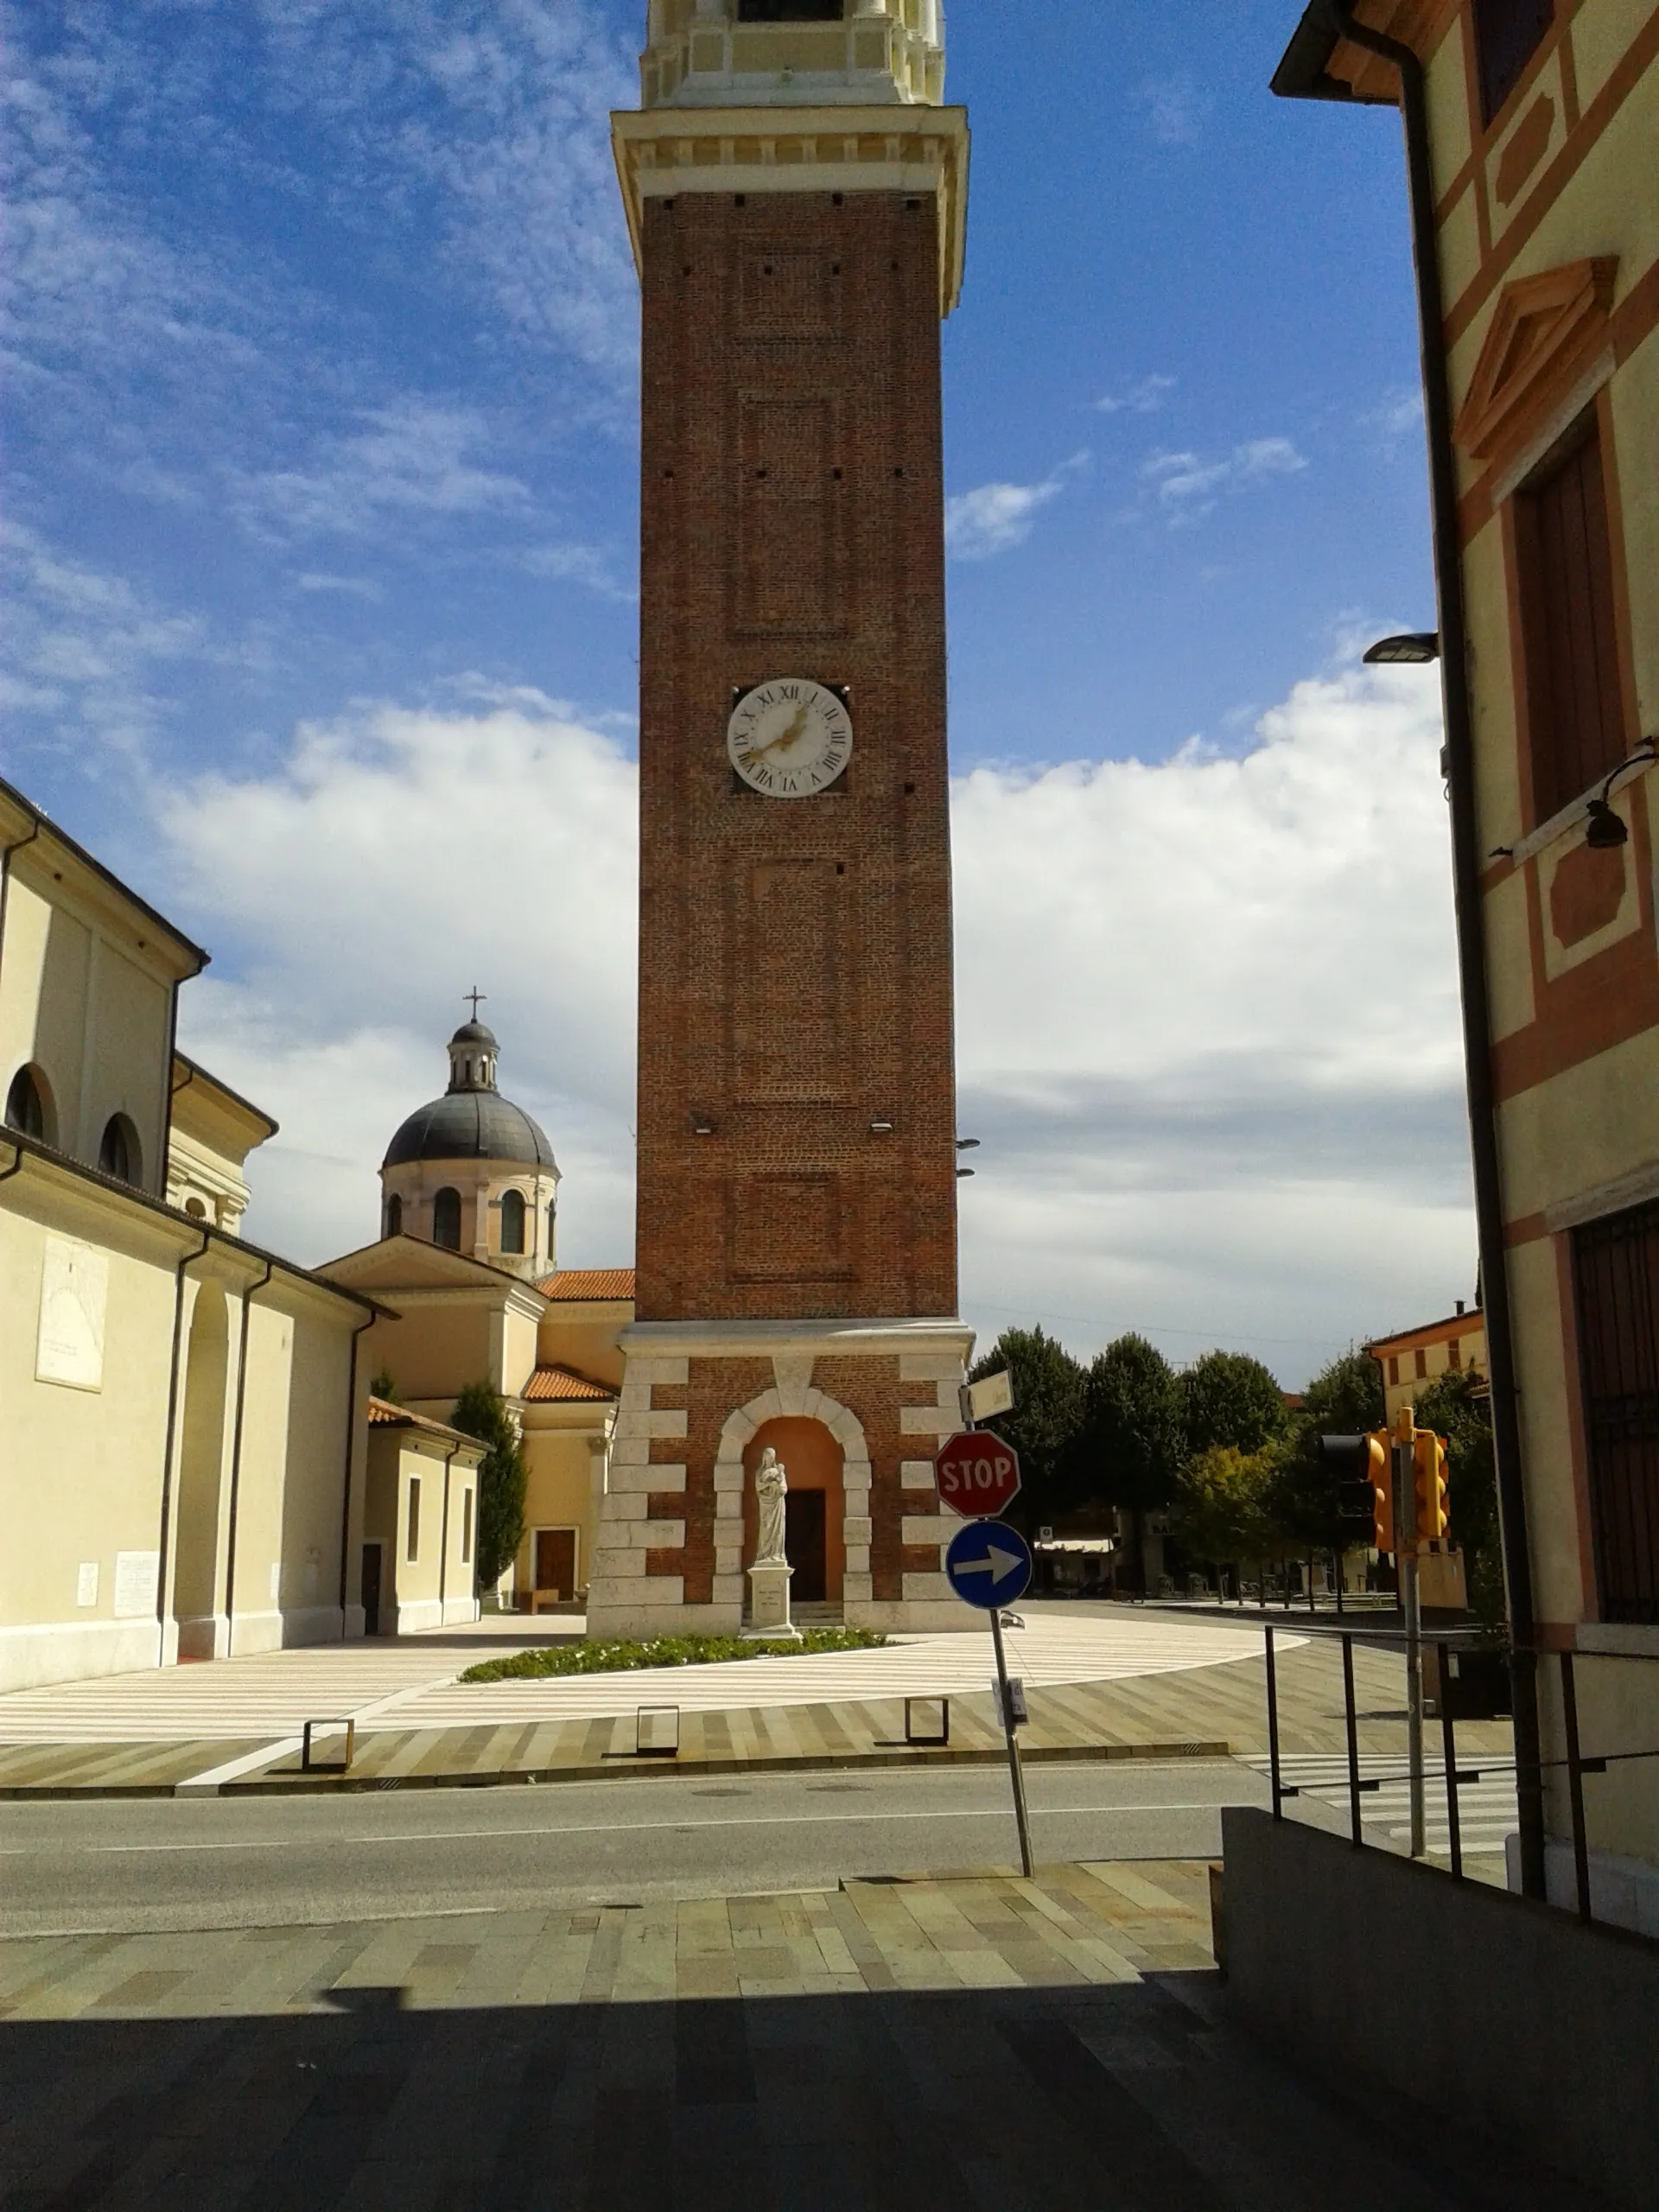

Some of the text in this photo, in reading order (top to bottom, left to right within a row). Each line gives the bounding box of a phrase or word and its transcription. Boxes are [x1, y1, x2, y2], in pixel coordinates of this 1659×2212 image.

[757, 690, 774, 704] XI
[780, 686, 798, 699] XII
[741, 709, 756, 721] X
[824, 708, 839, 721] II
[734, 732, 749, 746] IX
[831, 731, 846, 744] III
[754, 769, 773, 788] VII
[783, 777, 798, 791] VI
[810, 772, 822, 785] V
[942, 1457, 1011, 1492] STOP
